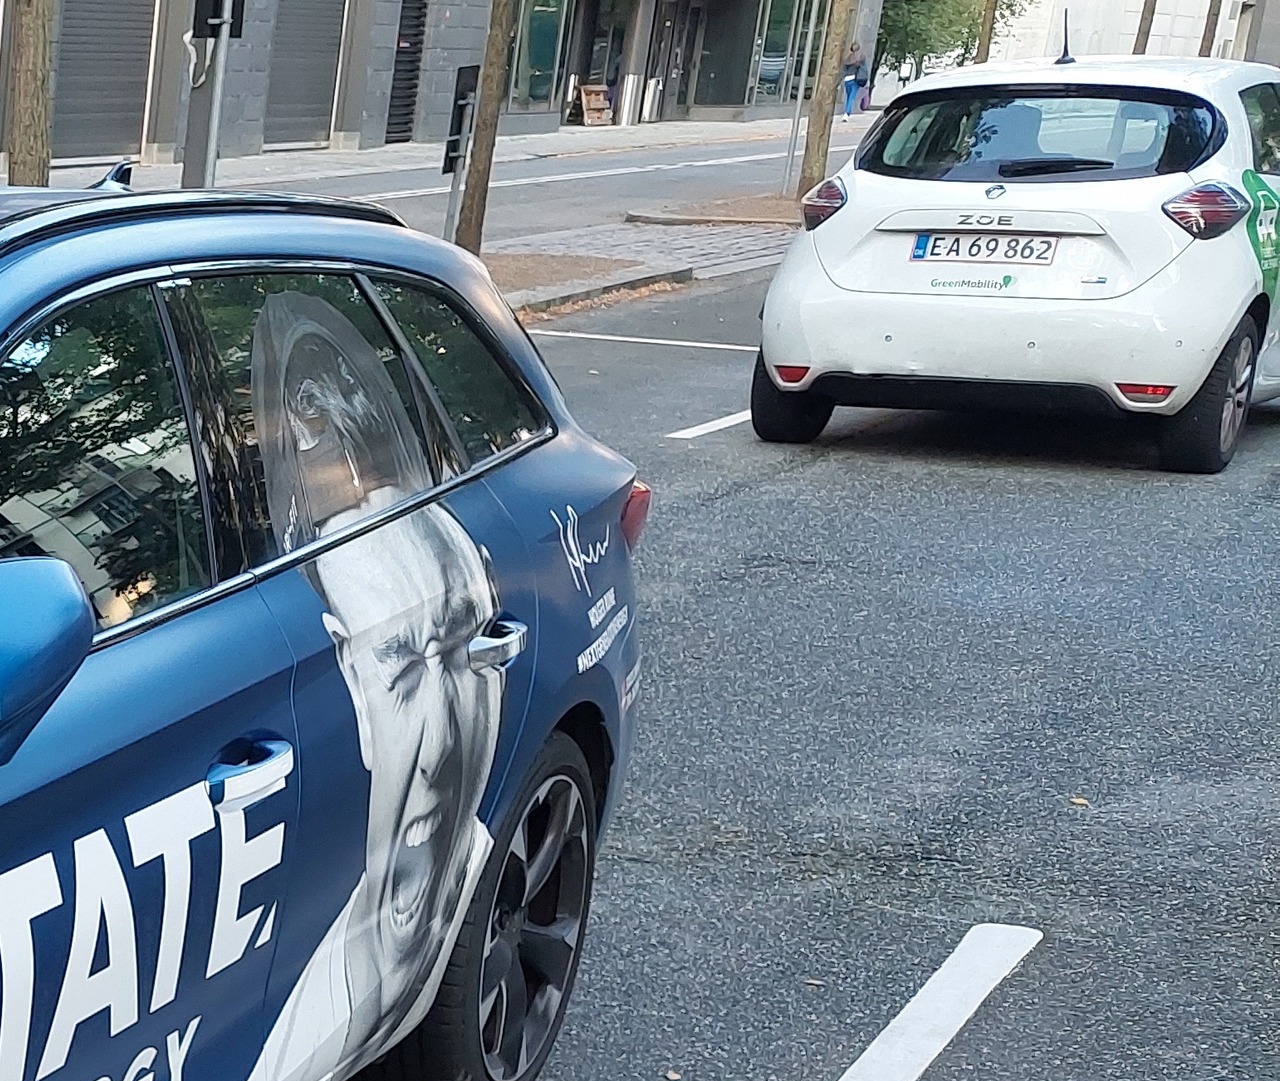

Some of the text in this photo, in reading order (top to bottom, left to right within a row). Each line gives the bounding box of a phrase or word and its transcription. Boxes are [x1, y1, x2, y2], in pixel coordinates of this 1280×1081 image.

[957, 214, 1014, 226] ZOE
[929, 236, 961, 257] EA
[968, 236, 999, 258] 69
[1003, 237, 1053, 261] 862
[930, 277, 1004, 291] GreenMobility
